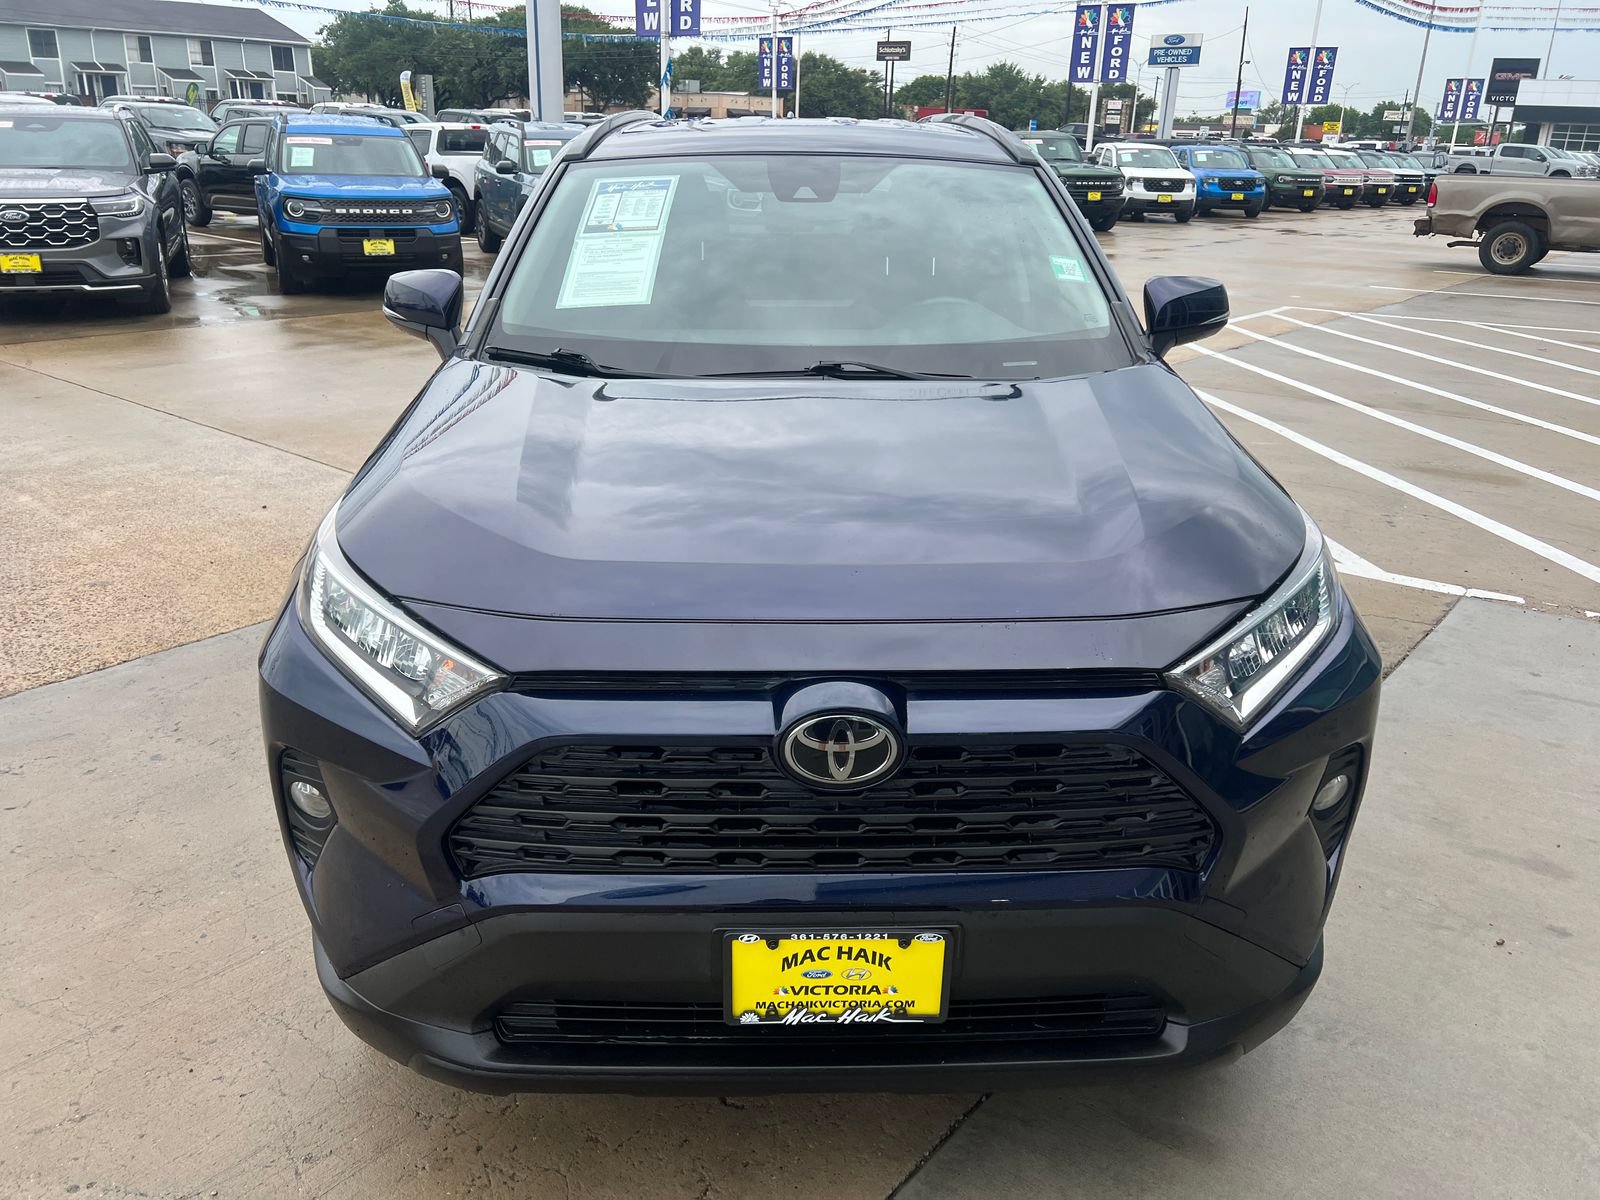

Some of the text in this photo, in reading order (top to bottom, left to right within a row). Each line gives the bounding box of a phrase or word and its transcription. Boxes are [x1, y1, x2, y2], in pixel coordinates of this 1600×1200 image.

[1077, 36, 1093, 79] NEW
[1108, 35, 1124, 79] FORD
[1153, 48, 1193, 56] PRE-OWNED
[1156, 55, 1188, 63] VEHICLES
[762, 58, 772, 87] NEW
[780, 57, 790, 87] FORD
[1495, 72, 1532, 80] GMC
[1287, 70, 1301, 102] NEW
[1313, 69, 1328, 102] FORD
[1443, 94, 1456, 118] NEW
[1464, 95, 1477, 119] FORD
[3, 212, 22, 220] Ford
[790, 932, 889, 941] 361-576-1221
[781, 945, 893, 972] MAC HAIK
[789, 984, 882, 996] VICTORIA
[755, 999, 916, 1010] MACHAIKVICTORIA.COM
[781, 1007, 900, 1025] Mac Haik
